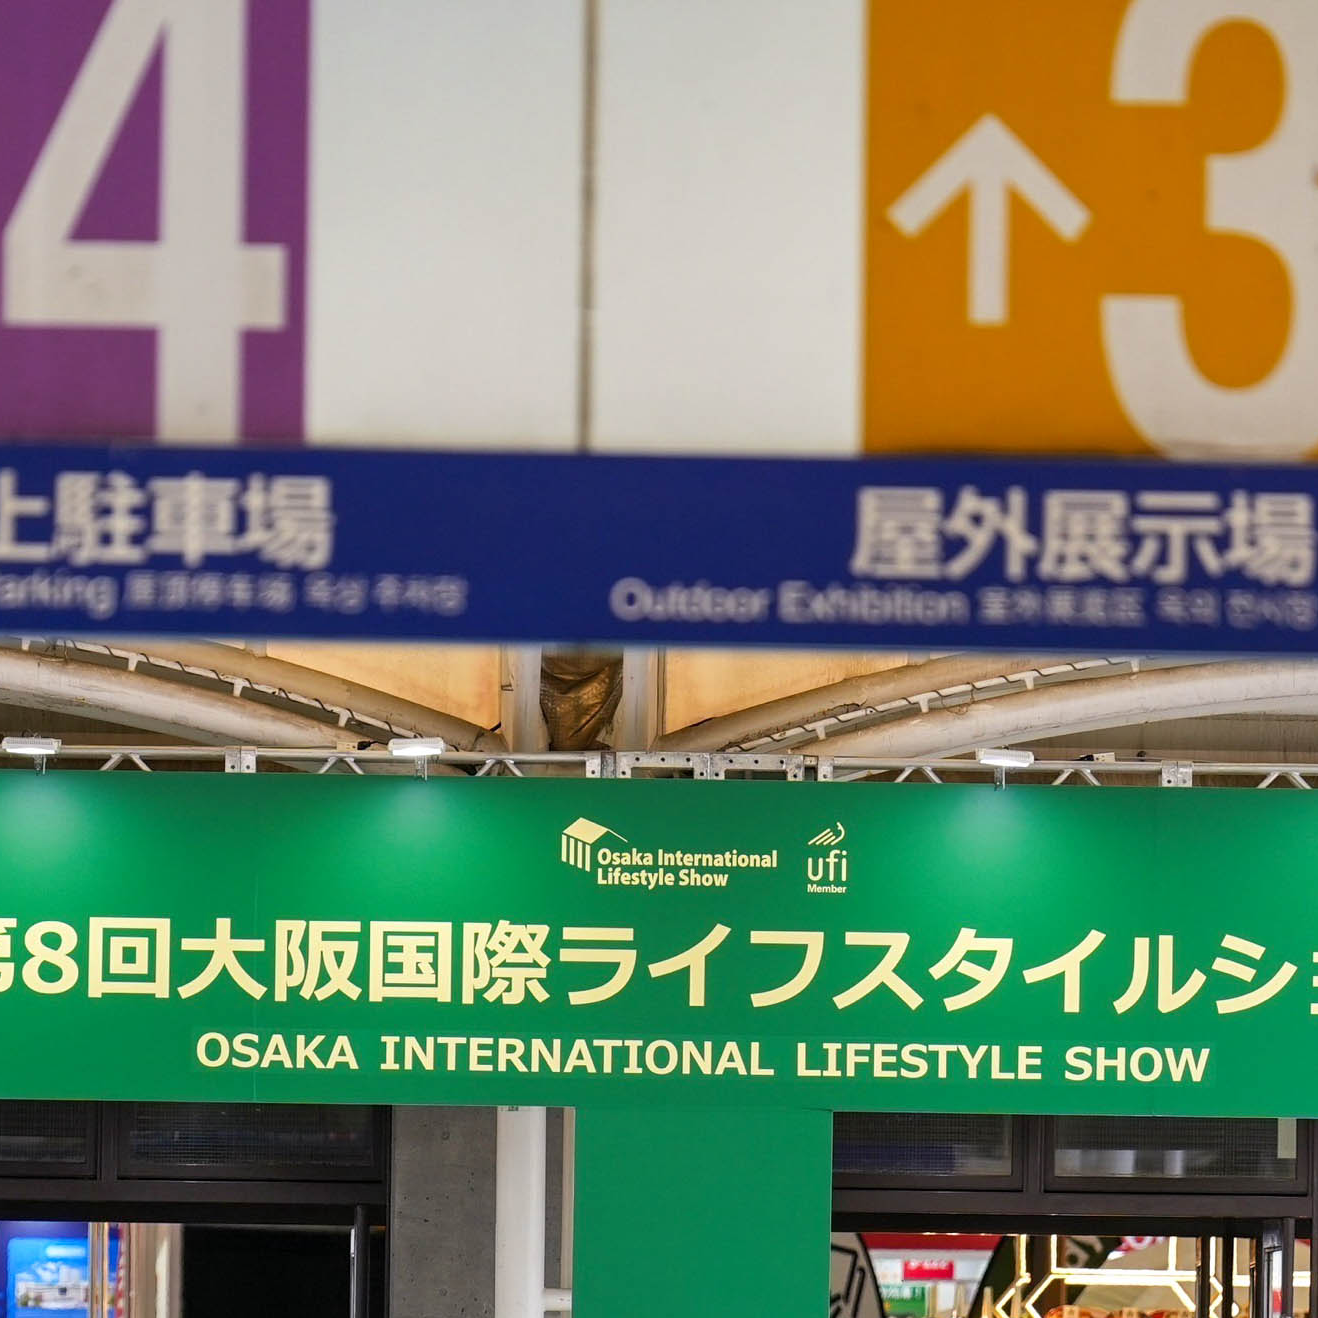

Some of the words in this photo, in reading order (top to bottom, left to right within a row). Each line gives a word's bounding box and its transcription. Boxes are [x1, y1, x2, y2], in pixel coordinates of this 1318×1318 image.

[2, 0, 288, 444] 4
[851, 486, 1318, 584] 屋外展示場
[609, 576, 771, 622] Outdoor
[778, 580, 970, 624] Exhibition
[597, 848, 653, 866] Osaka
[658, 849, 778, 868] International
[807, 850, 847, 882] ufi
[597, 867, 675, 890] Lifestyle
[679, 869, 729, 887] Show
[807, 883, 847, 894] Member
[195, 1032, 359, 1071] OSAKA
[380, 1035, 775, 1077] INTERNATIONAL
[797, 1042, 1043, 1081] LIFESTYLE
[1064, 1045, 1211, 1083] SHOW
